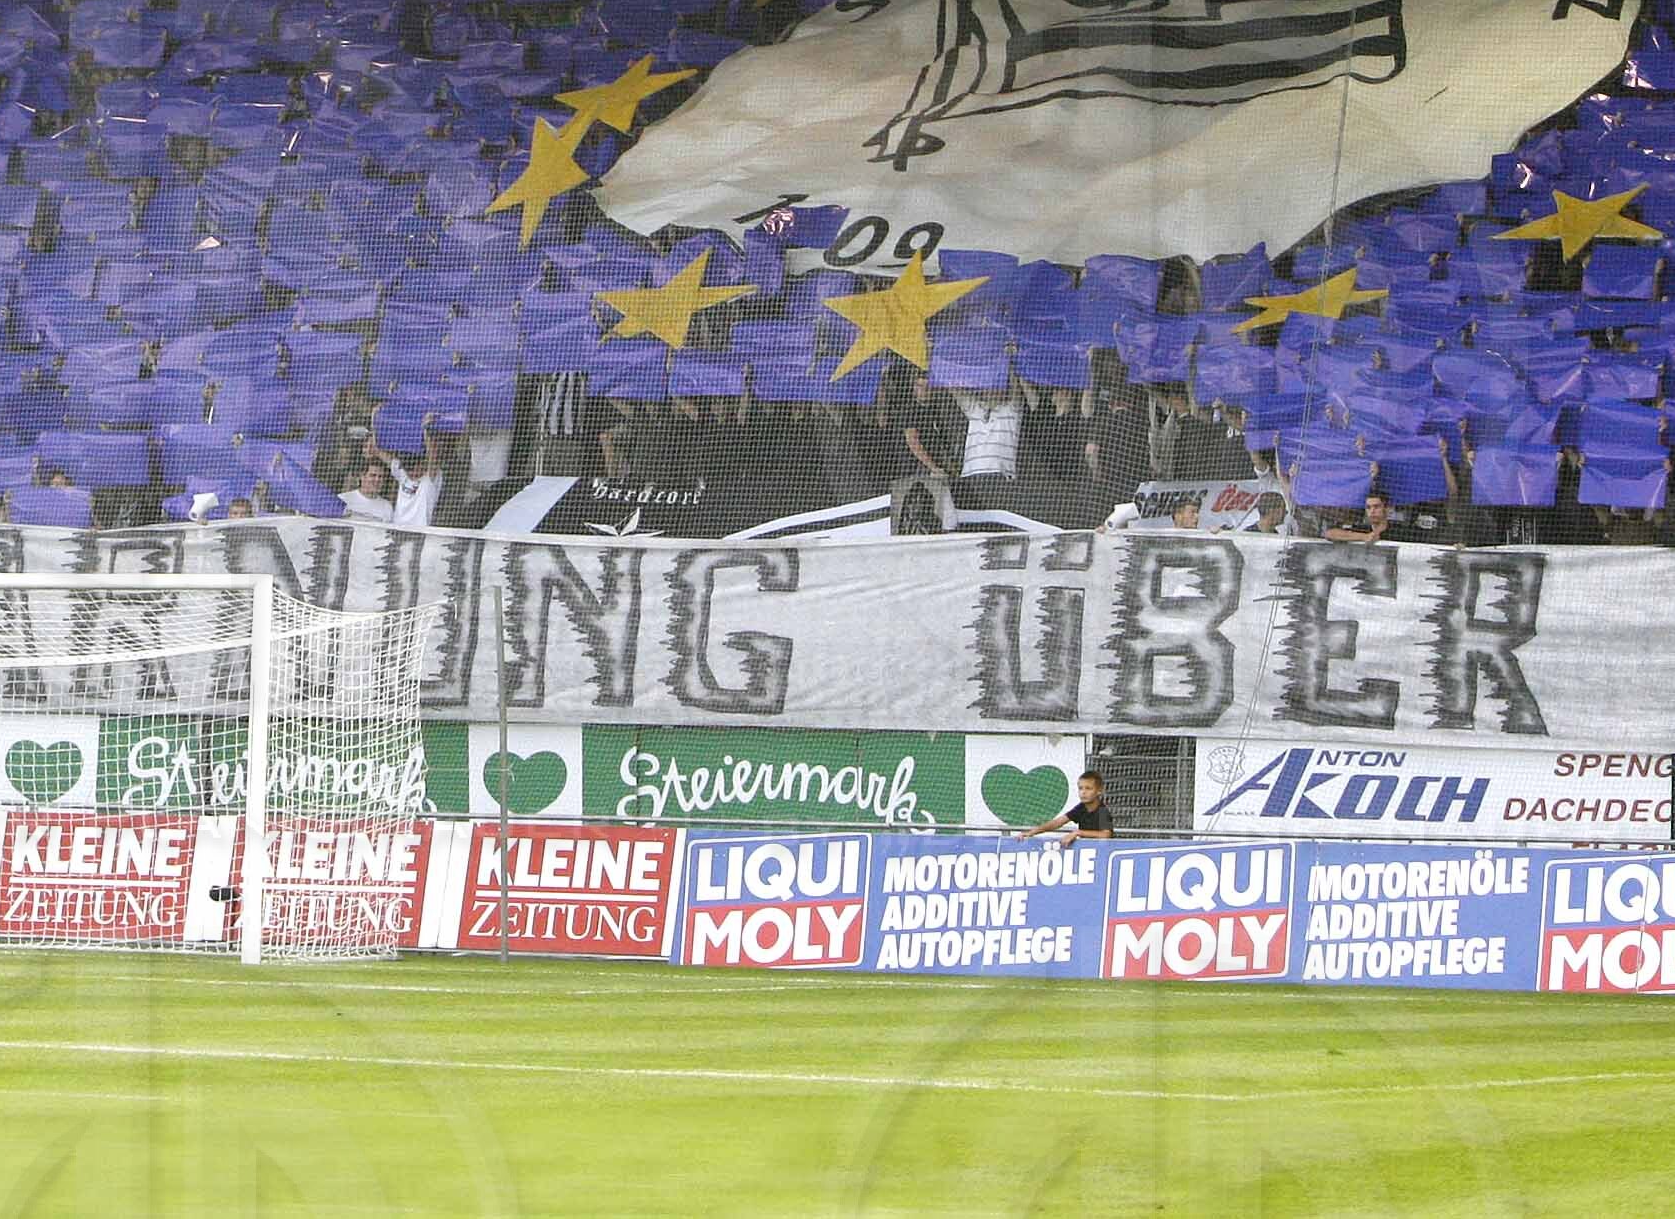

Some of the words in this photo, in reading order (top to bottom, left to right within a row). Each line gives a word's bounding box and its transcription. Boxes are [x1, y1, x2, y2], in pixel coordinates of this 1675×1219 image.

[967, 530, 1549, 737] ÜBER
[616, 745, 937, 834] Steiermark
[13, 826, 188, 878] KLEINE
[477, 836, 663, 891] KLEINE
[694, 840, 862, 903] LIQUI
[889, 841, 1097, 893] MOTORENÖLE
[1307, 849, 1531, 903] MOTORENÖLE
[3, 887, 179, 927] ZEITUNG
[1115, 846, 1285, 915] LIQUI
[469, 901, 657, 944] ZEITUNG
[685, 903, 863, 968] MOLY
[880, 891, 1029, 932] ADDITIVE
[1305, 899, 1460, 942] ADDITIVE
[875, 926, 1074, 970] AUTOPFLEGE
[1109, 913, 1290, 980] MOLY
[1302, 937, 1506, 982] AUTOPFLEGE
